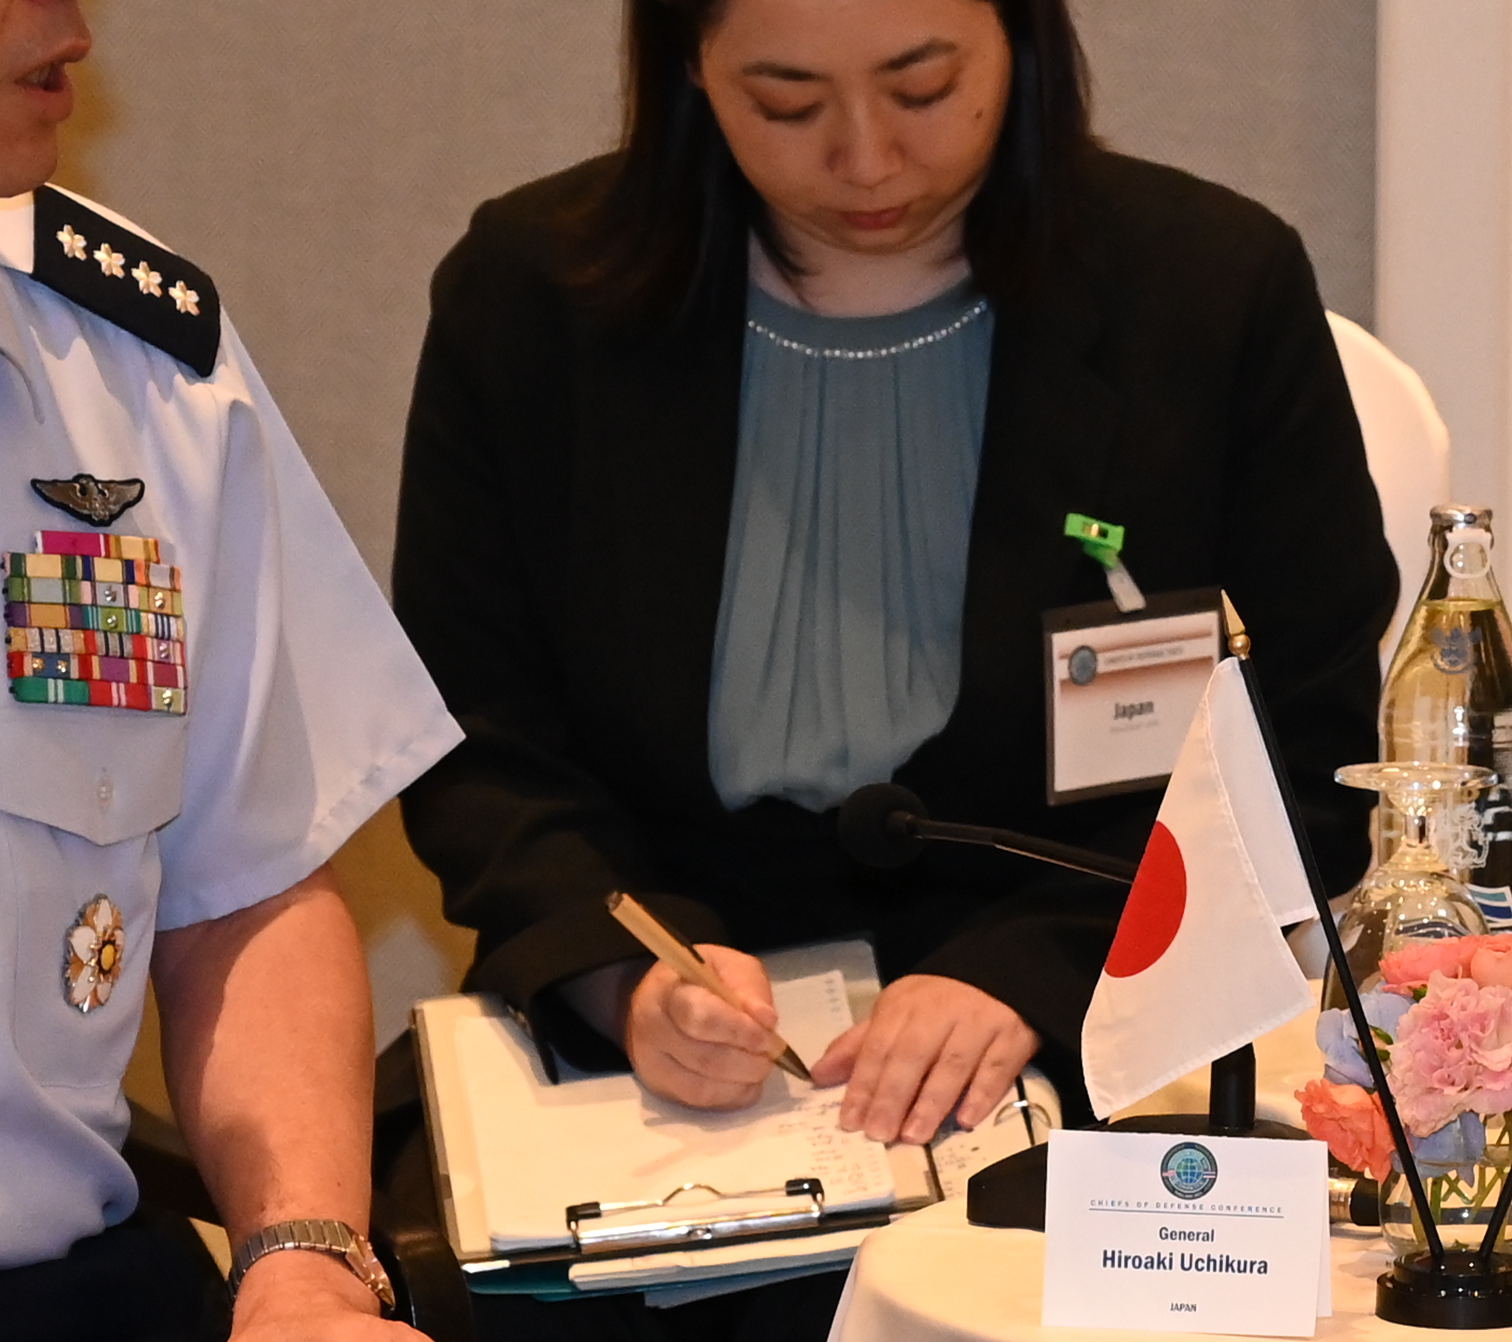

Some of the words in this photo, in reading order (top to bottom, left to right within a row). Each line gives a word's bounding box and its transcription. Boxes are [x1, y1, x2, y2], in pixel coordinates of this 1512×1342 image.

[1090, 1199, 1130, 1208] CHIEFS
[1155, 1202, 1204, 1211] DEFENSE
[1210, 1204, 1283, 1214] CONFERENCE
[1159, 1226, 1215, 1242] General
[1102, 1249, 1174, 1271] Hiroaki
[1180, 1253, 1269, 1275] Uchikura
[1169, 1302, 1197, 1313] JAPAN
